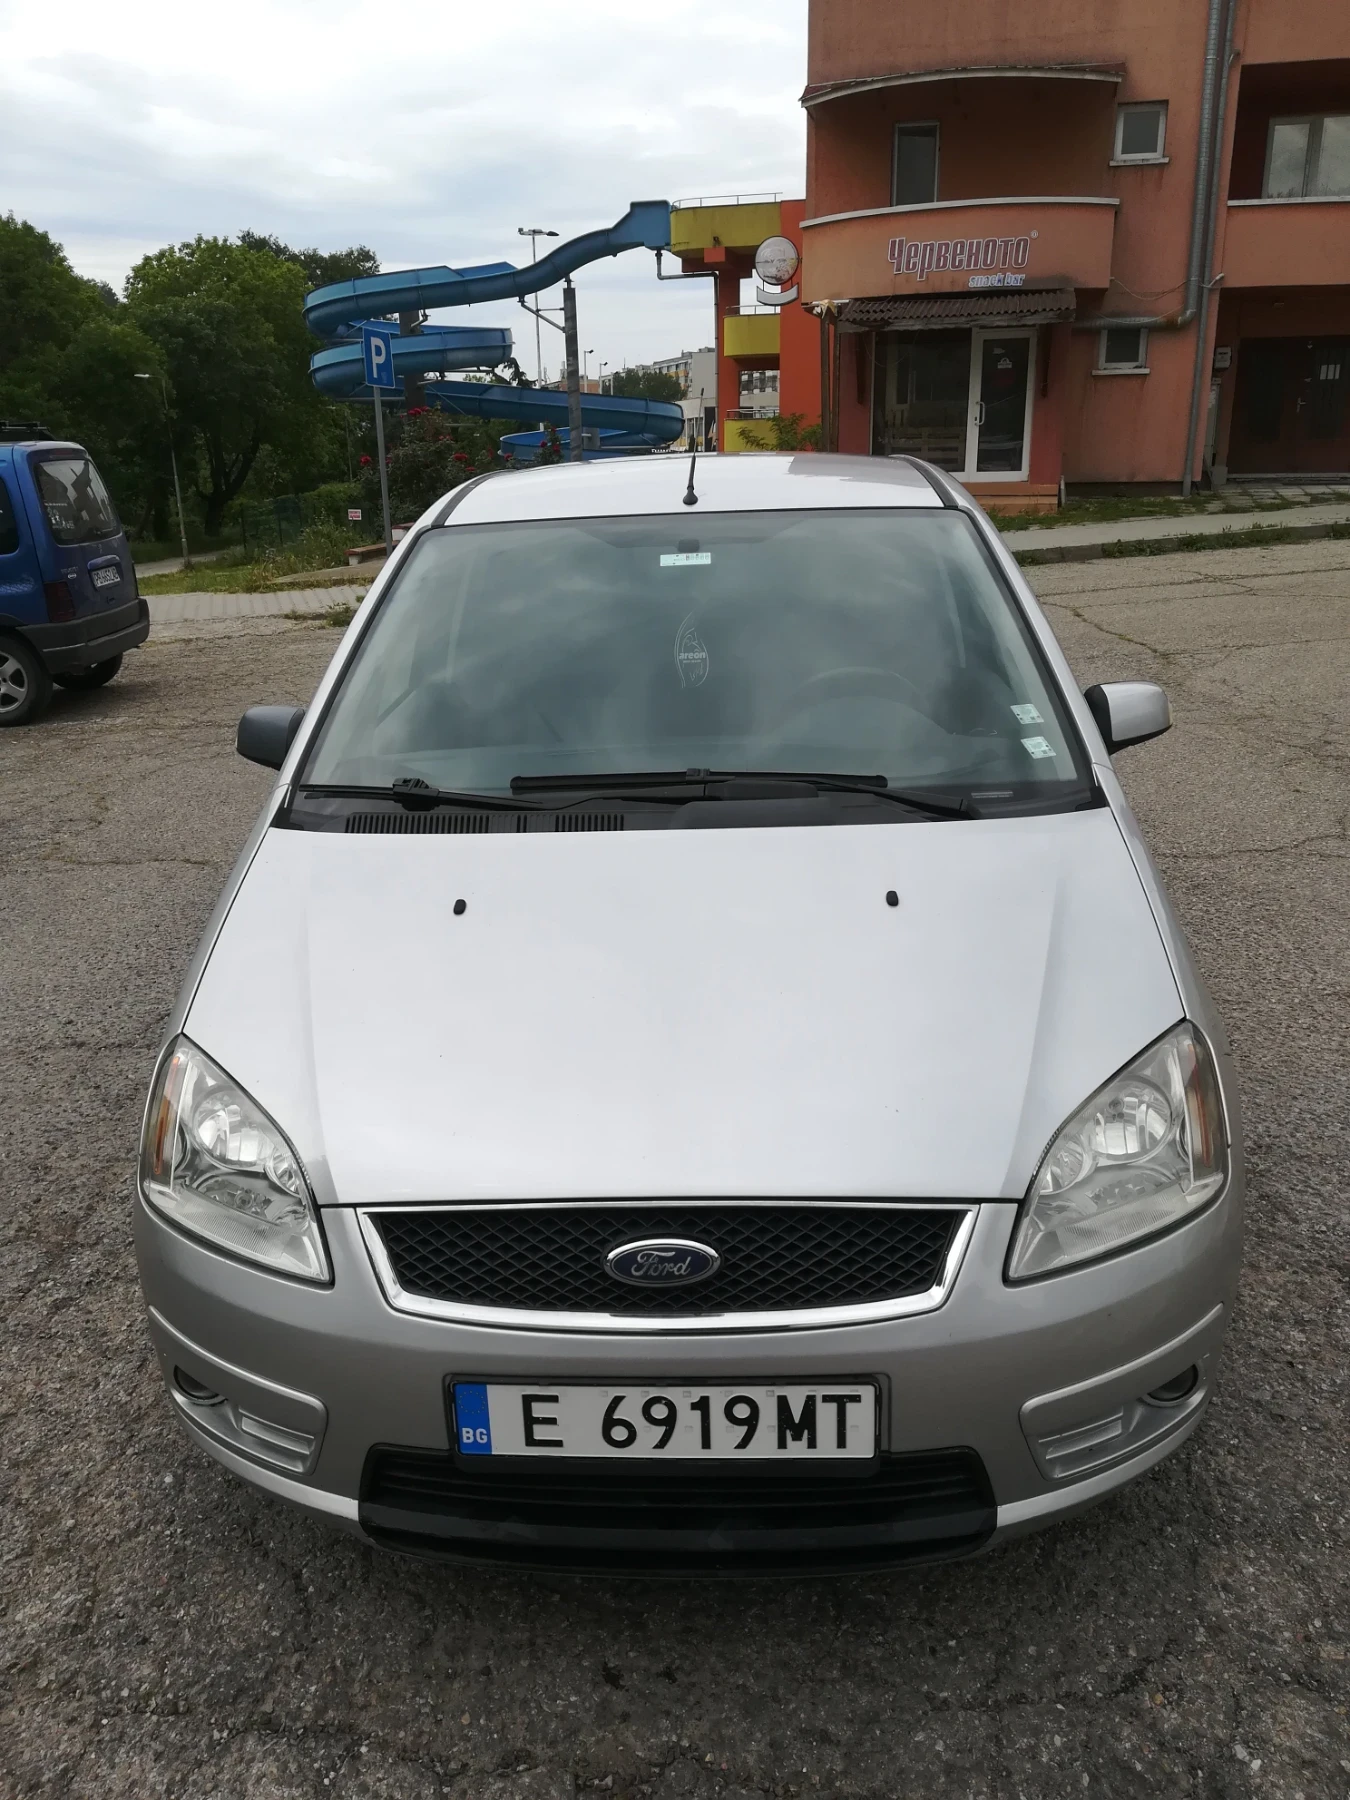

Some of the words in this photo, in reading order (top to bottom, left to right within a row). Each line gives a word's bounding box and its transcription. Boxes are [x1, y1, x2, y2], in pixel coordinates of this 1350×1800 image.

[969, 273, 1004, 287] snack
[1004, 272, 1025, 286] bar
[370, 336, 386, 378] P
[631, 1250, 691, 1276] Ford
[521, 1394, 563, 1448] E
[462, 1427, 488, 1444] BG
